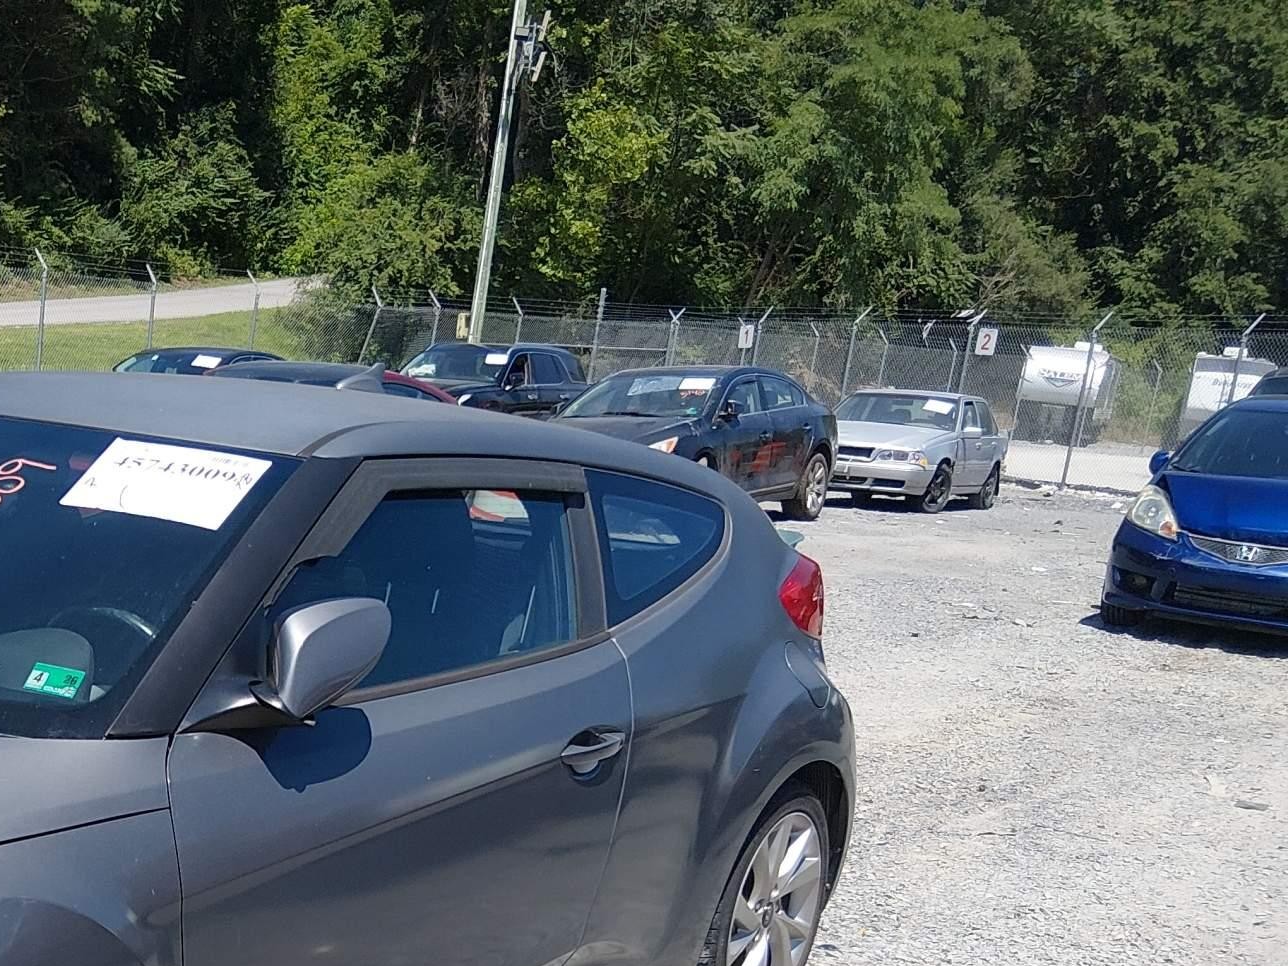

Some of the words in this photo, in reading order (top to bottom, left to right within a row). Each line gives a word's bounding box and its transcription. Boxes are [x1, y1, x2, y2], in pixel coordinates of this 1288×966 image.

[980, 334, 991, 350] 2
[114, 455, 238, 482] 45743009
[33, 672, 43, 684] 4
[63, 674, 79, 686] 26
